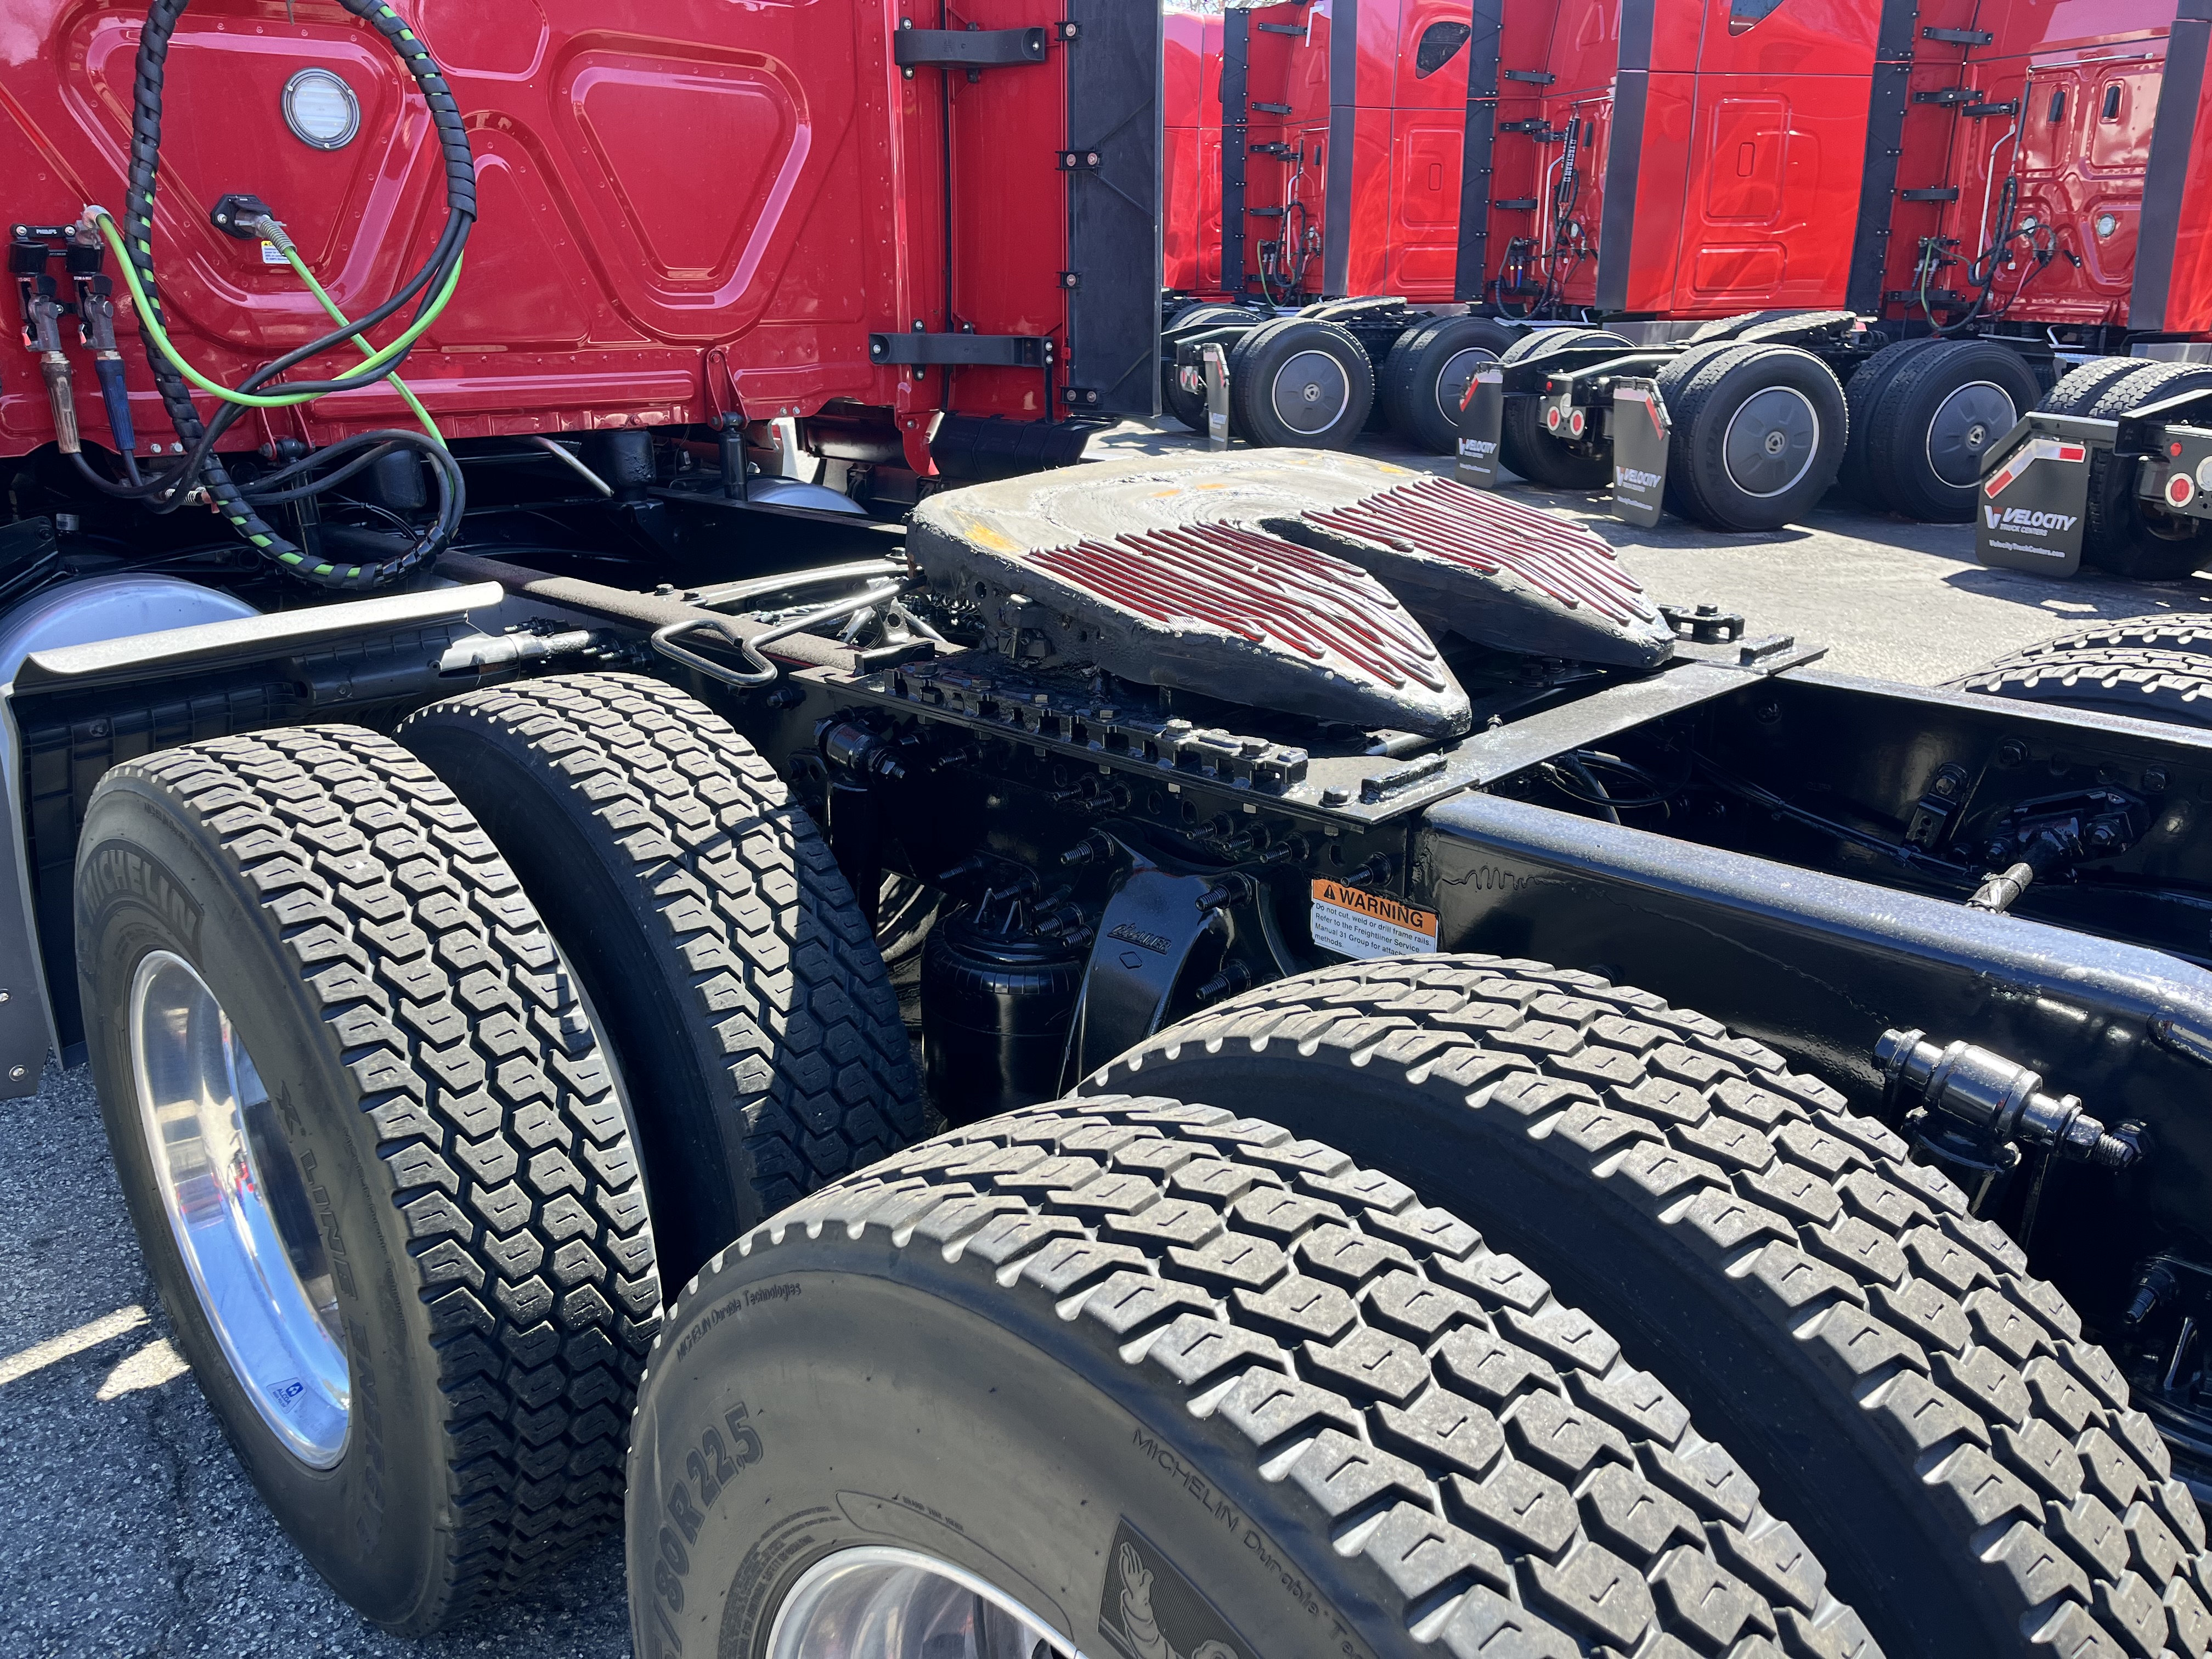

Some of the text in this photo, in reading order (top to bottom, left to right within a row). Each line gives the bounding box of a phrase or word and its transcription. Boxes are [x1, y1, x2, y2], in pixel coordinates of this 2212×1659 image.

[1465, 438, 1497, 454] VELOCITY
[1624, 467, 1662, 488] VELOCITY
[2002, 507, 2078, 531] VELOCITY
[82, 849, 198, 942] MICHELIN
[1339, 887, 1424, 928] WARNING
[1314, 934, 1344, 949] methods.
[1315, 923, 1338, 936] Manual
[1339, 930, 1346, 939] 31
[1348, 934, 1369, 947] Group
[1370, 940, 1380, 950] for
[1316, 902, 1324, 912] Do
[1327, 905, 1337, 915] not
[1339, 910, 1351, 921] cut,
[1352, 915, 1368, 926] weld
[1378, 922, 1391, 933] drill
[1393, 928, 1413, 940] frame
[1414, 934, 1431, 946] rails.
[1316, 912, 1333, 924] Refer
[1342, 921, 1353, 930] the
[1355, 924, 1393, 944] Freightliner
[1394, 939, 1420, 953] Service
[343, 1127, 372, 1200] MICHELIN
[300, 1149, 359, 1301] LINE
[676, 1282, 802, 1363] MICHELIN Durable Technologies
[276, 1389, 291, 1405] ALCOA
[1132, 1429, 1239, 1533] MICHELIN
[1243, 1529, 1321, 1618] Durable
